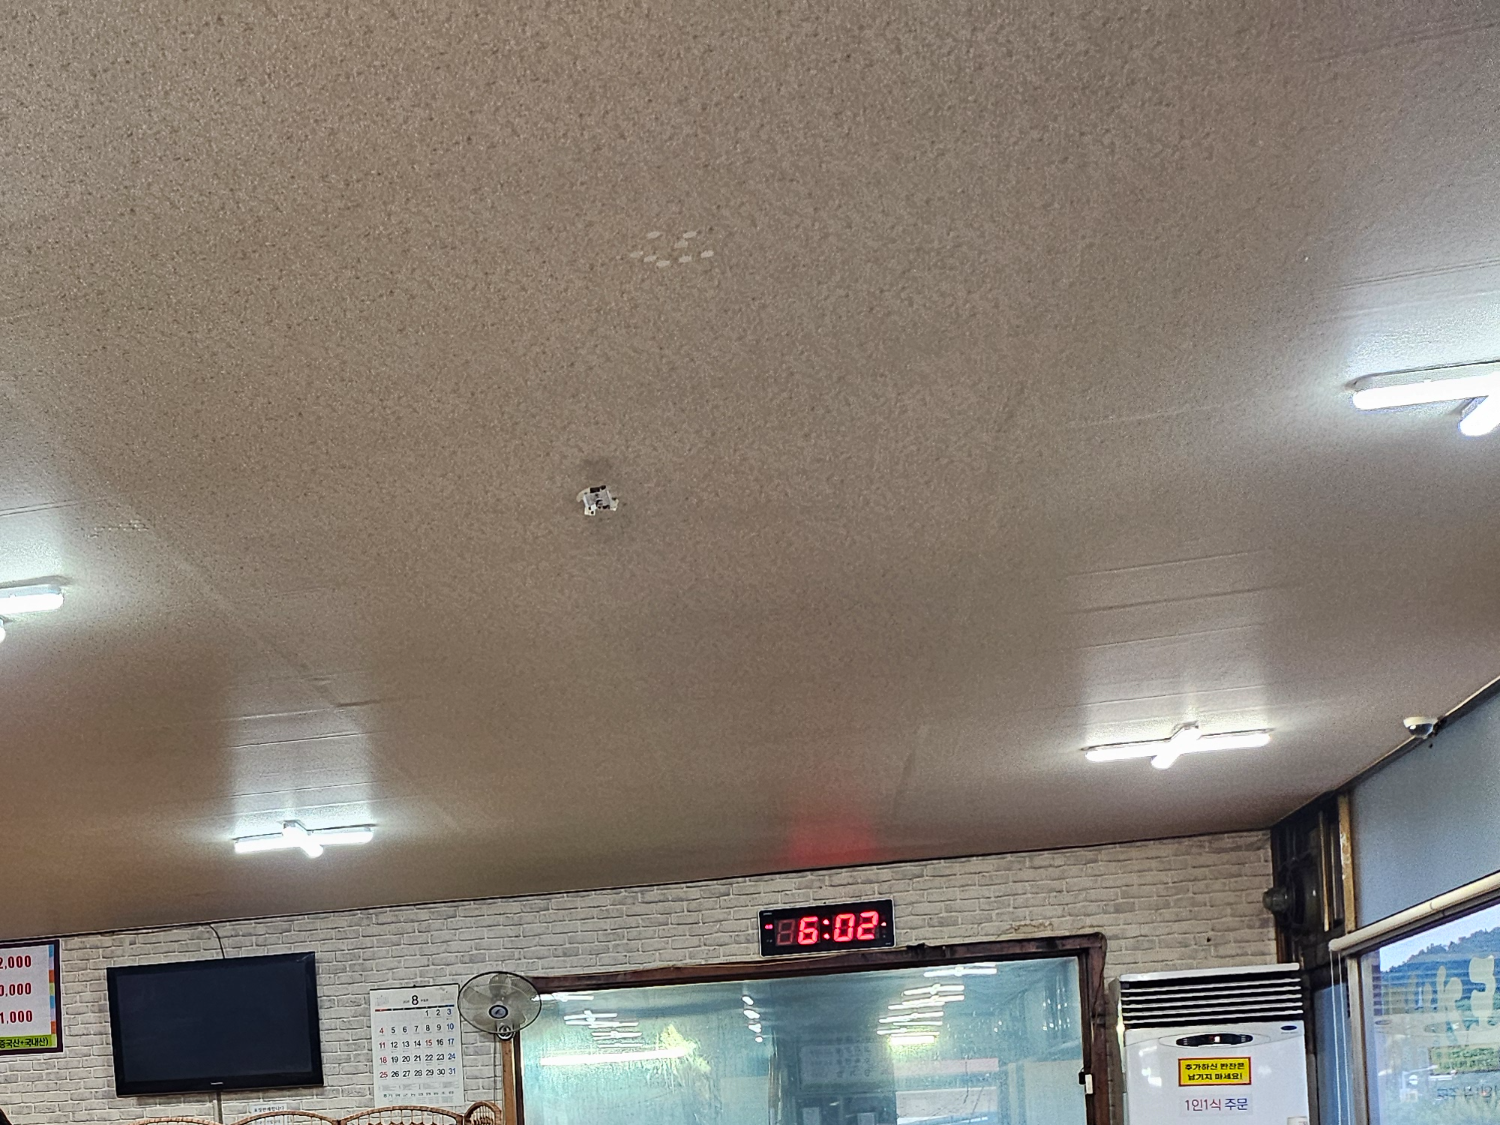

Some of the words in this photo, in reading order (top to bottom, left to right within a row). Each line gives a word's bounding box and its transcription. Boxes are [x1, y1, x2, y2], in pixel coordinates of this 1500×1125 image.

[798, 911, 879, 945] 6:02
[412, 995, 419, 1005] 8
[0, 1010, 33, 1024] 1,000
[1185, 1098, 1221, 1111] 1인1식
[1225, 1098, 1248, 1110] 주문
